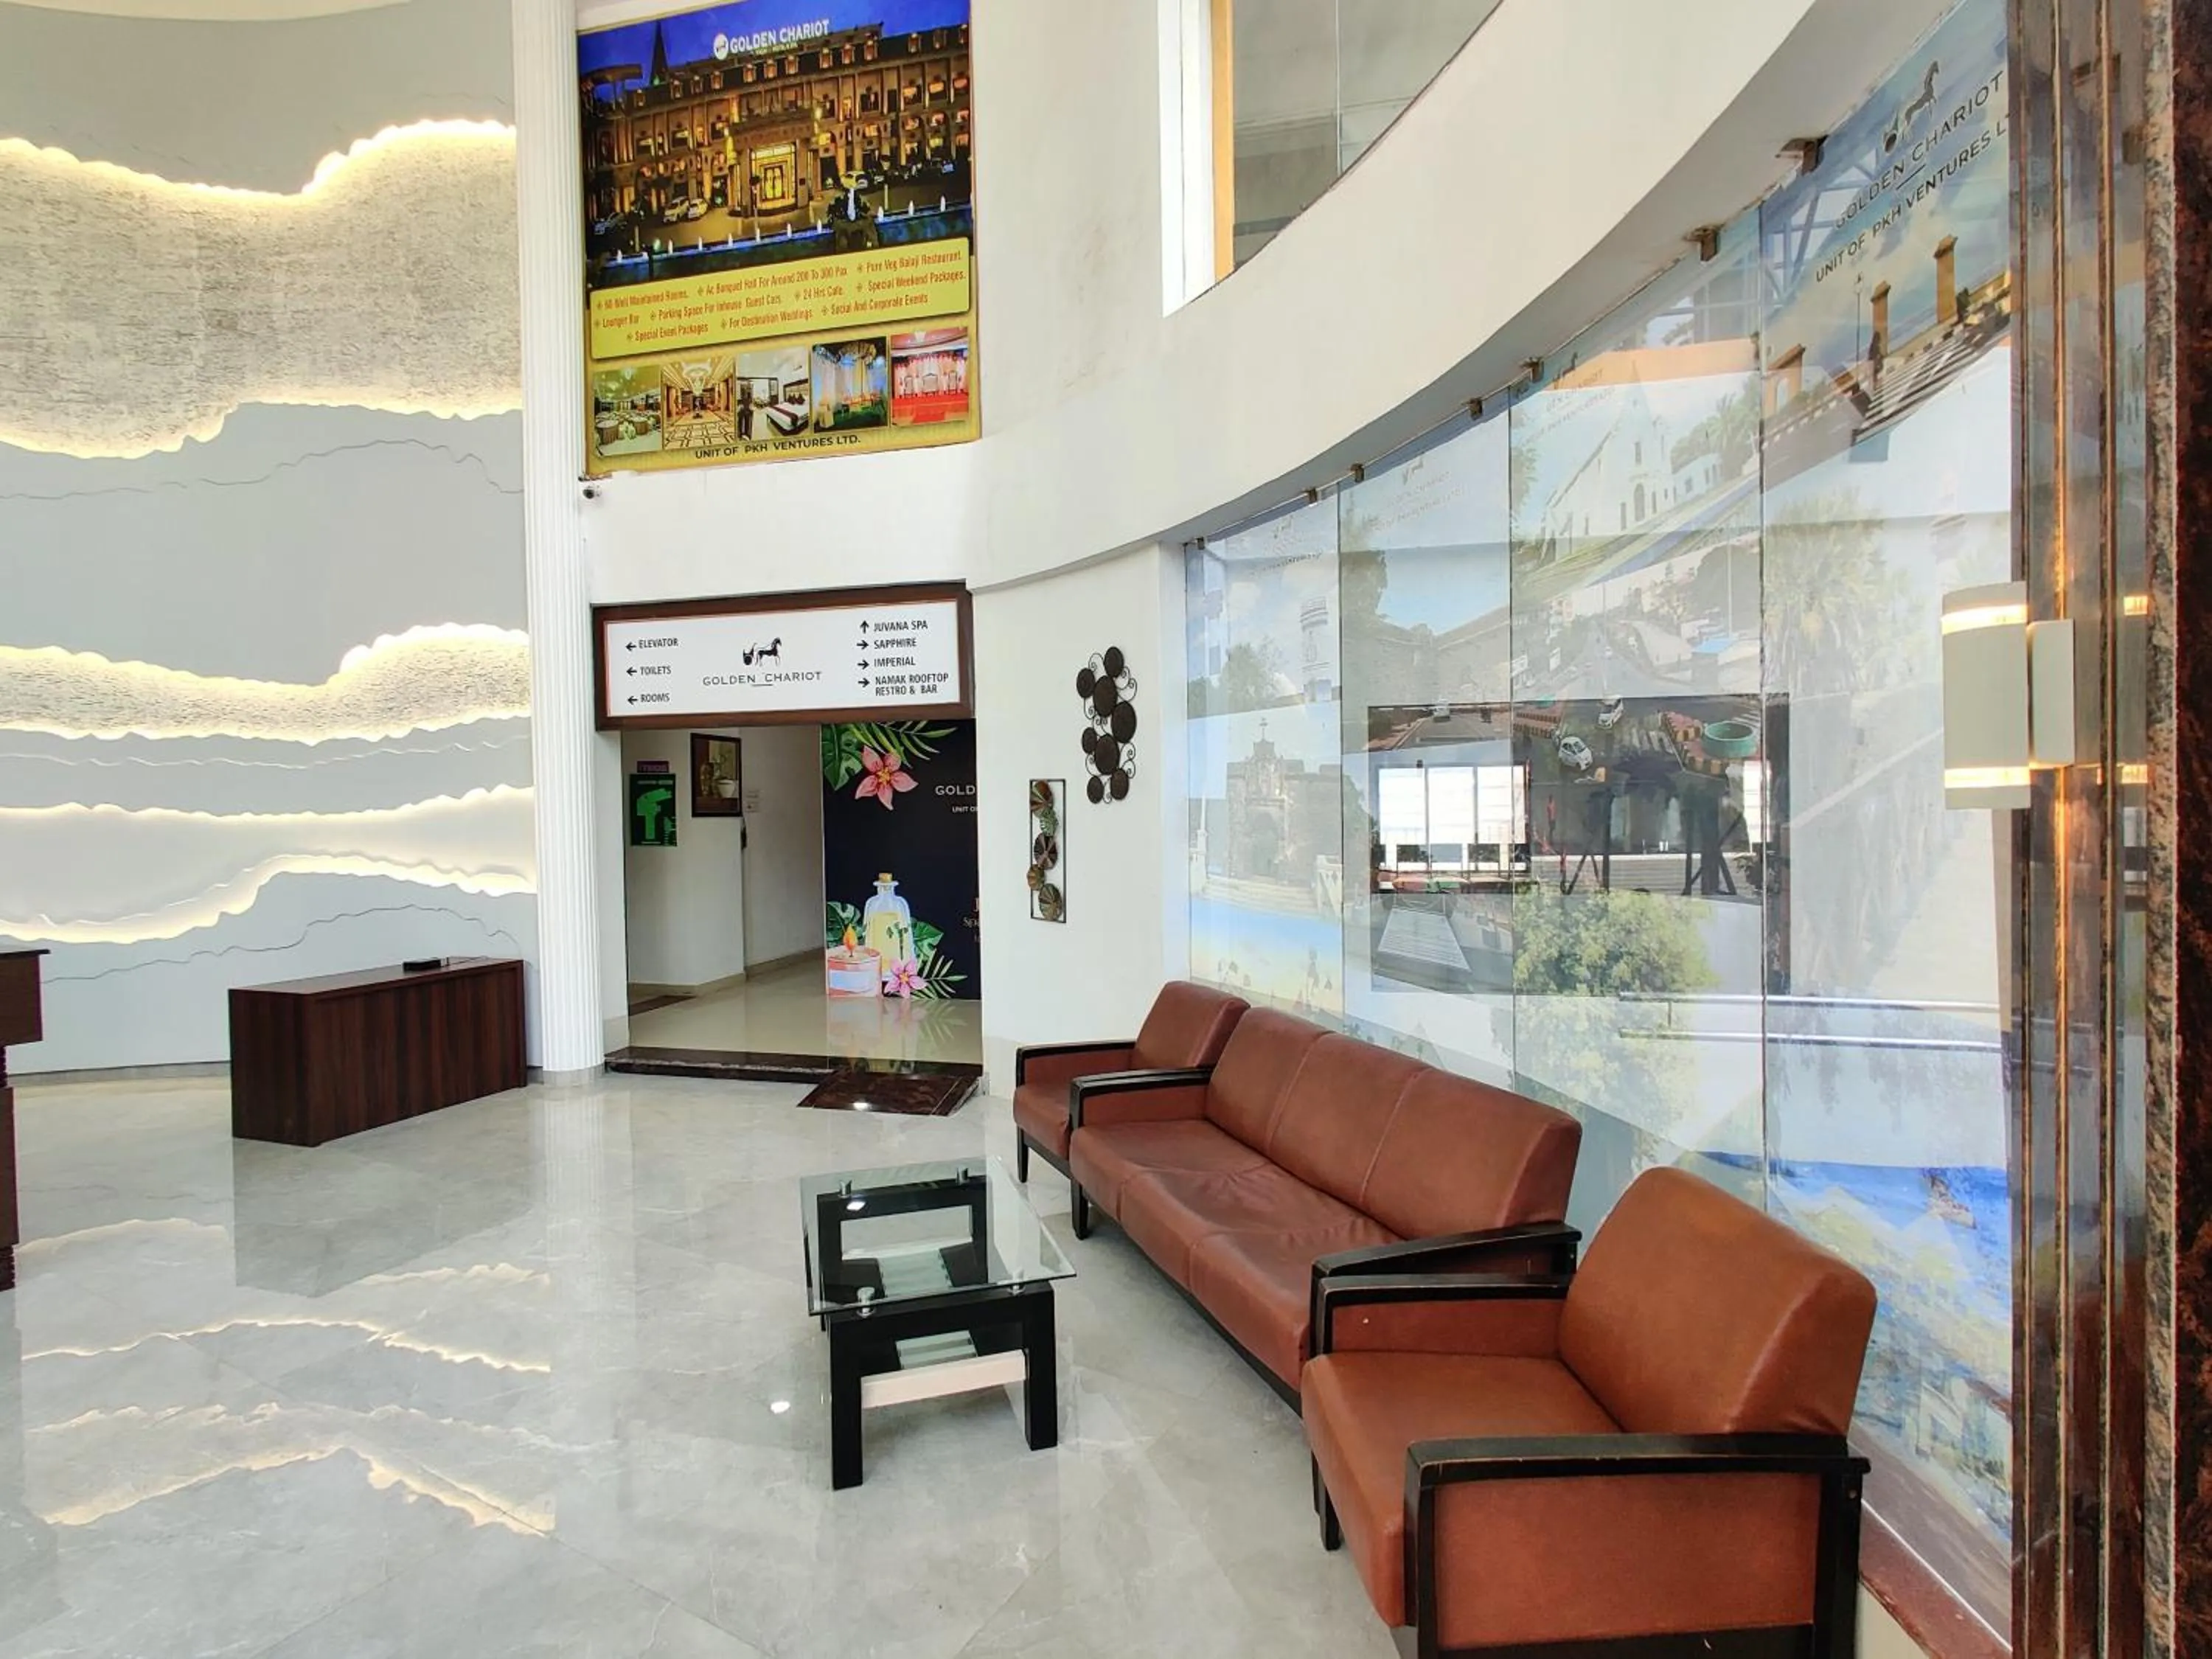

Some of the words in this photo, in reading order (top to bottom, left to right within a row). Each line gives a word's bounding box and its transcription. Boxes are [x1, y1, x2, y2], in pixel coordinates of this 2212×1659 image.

[730, 29, 776, 54] GOLDEN
[779, 18, 830, 43] CHARIOT
[1835, 159, 1905, 229] GOLDEN
[1911, 70, 2004, 161] CHARIOT
[1816, 248, 1845, 283] UNIT
[1847, 232, 1866, 256] OF
[1872, 203, 1902, 238] PKH
[1905, 130, 1992, 209] VENTURES
[885, 260, 897, 272] Veg
[759, 276, 769, 288] For
[811, 269, 819, 280] To
[868, 279, 894, 293] Special
[896, 274, 928, 288] Weekend
[658, 308, 682, 321] Parking
[684, 305, 703, 319] Space
[729, 317, 740, 328] For
[635, 328, 658, 342] Special
[678, 323, 709, 336] Packages
[695, 448, 721, 459] UNIT
[723, 447, 738, 456] OF
[744, 443, 768, 454] PKH
[773, 437, 833, 451] VENTURES
[836, 434, 860, 444] LTD.
[874, 621, 909, 632] JUVANA
[911, 620, 928, 630] SPA
[639, 638, 679, 649] ELEVATOR
[874, 638, 917, 649] SAPPHIRE
[874, 656, 916, 667] IMPERIAL
[640, 666, 672, 675] TOILETS
[703, 675, 756, 686] GOLDEN
[765, 671, 821, 682] CHARIOT
[875, 675, 906, 685] NAMAK
[908, 672, 949, 684] ROOFTOP
[875, 686, 907, 696] RESTRO
[909, 685, 916, 695] &
[920, 684, 937, 694] BAR
[640, 692, 670, 703] ROOMS
